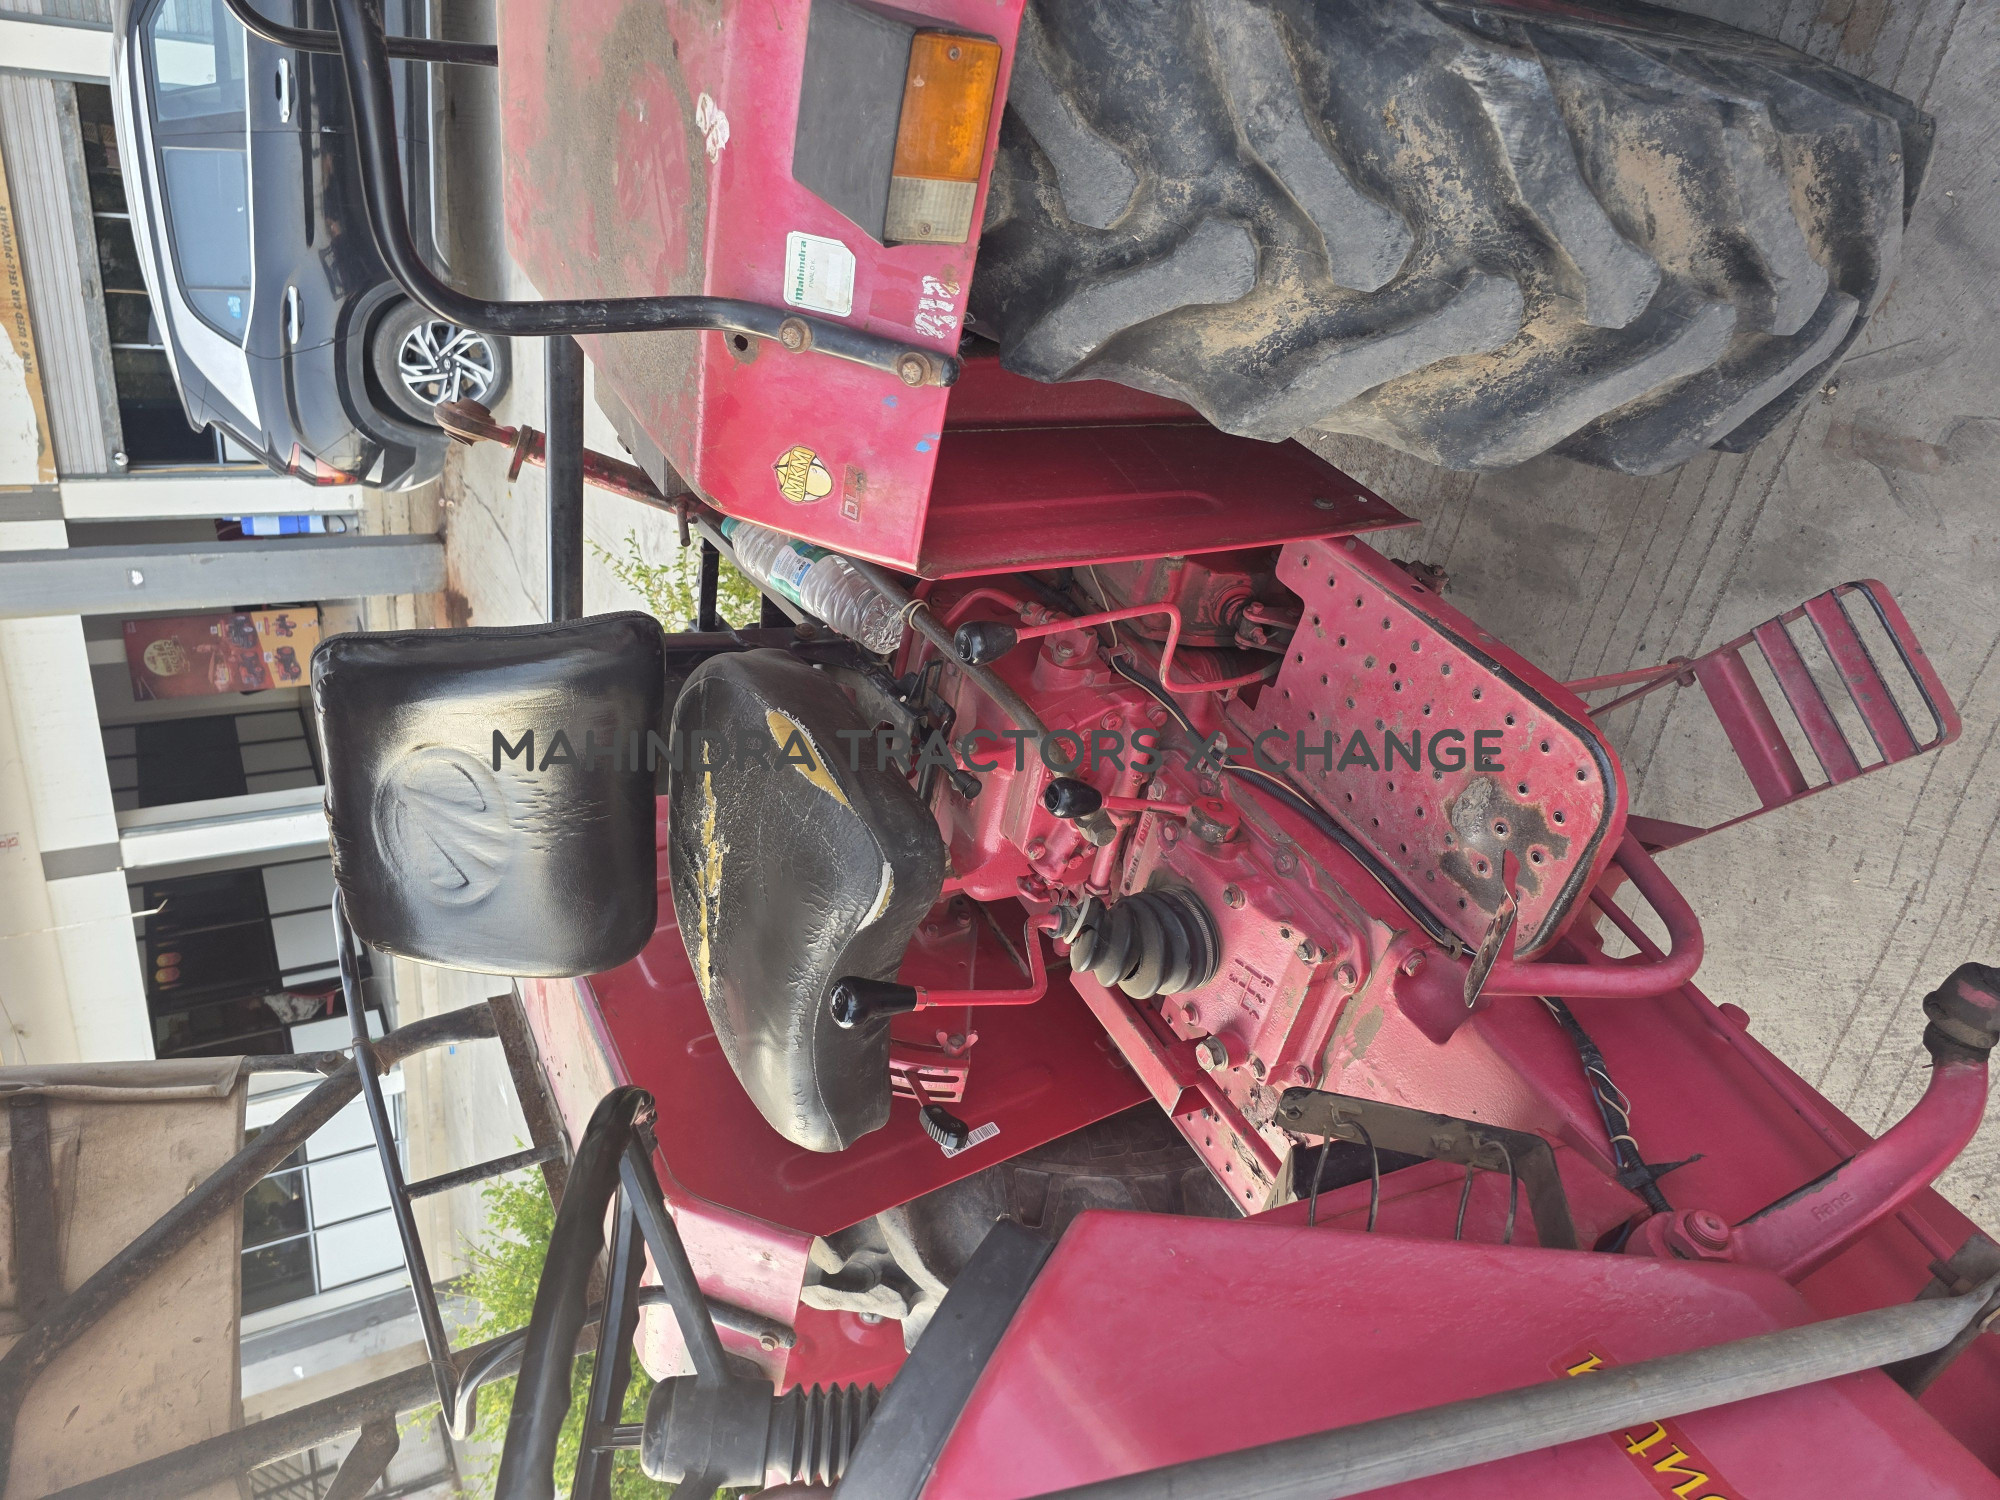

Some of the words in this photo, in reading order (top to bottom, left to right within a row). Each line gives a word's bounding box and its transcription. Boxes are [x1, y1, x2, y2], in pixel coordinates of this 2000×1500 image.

[795, 240, 807, 301] Mahindra
[11, 289, 22, 313] CAR
[15, 313, 27, 338] USED
[782, 449, 813, 500] MKM
